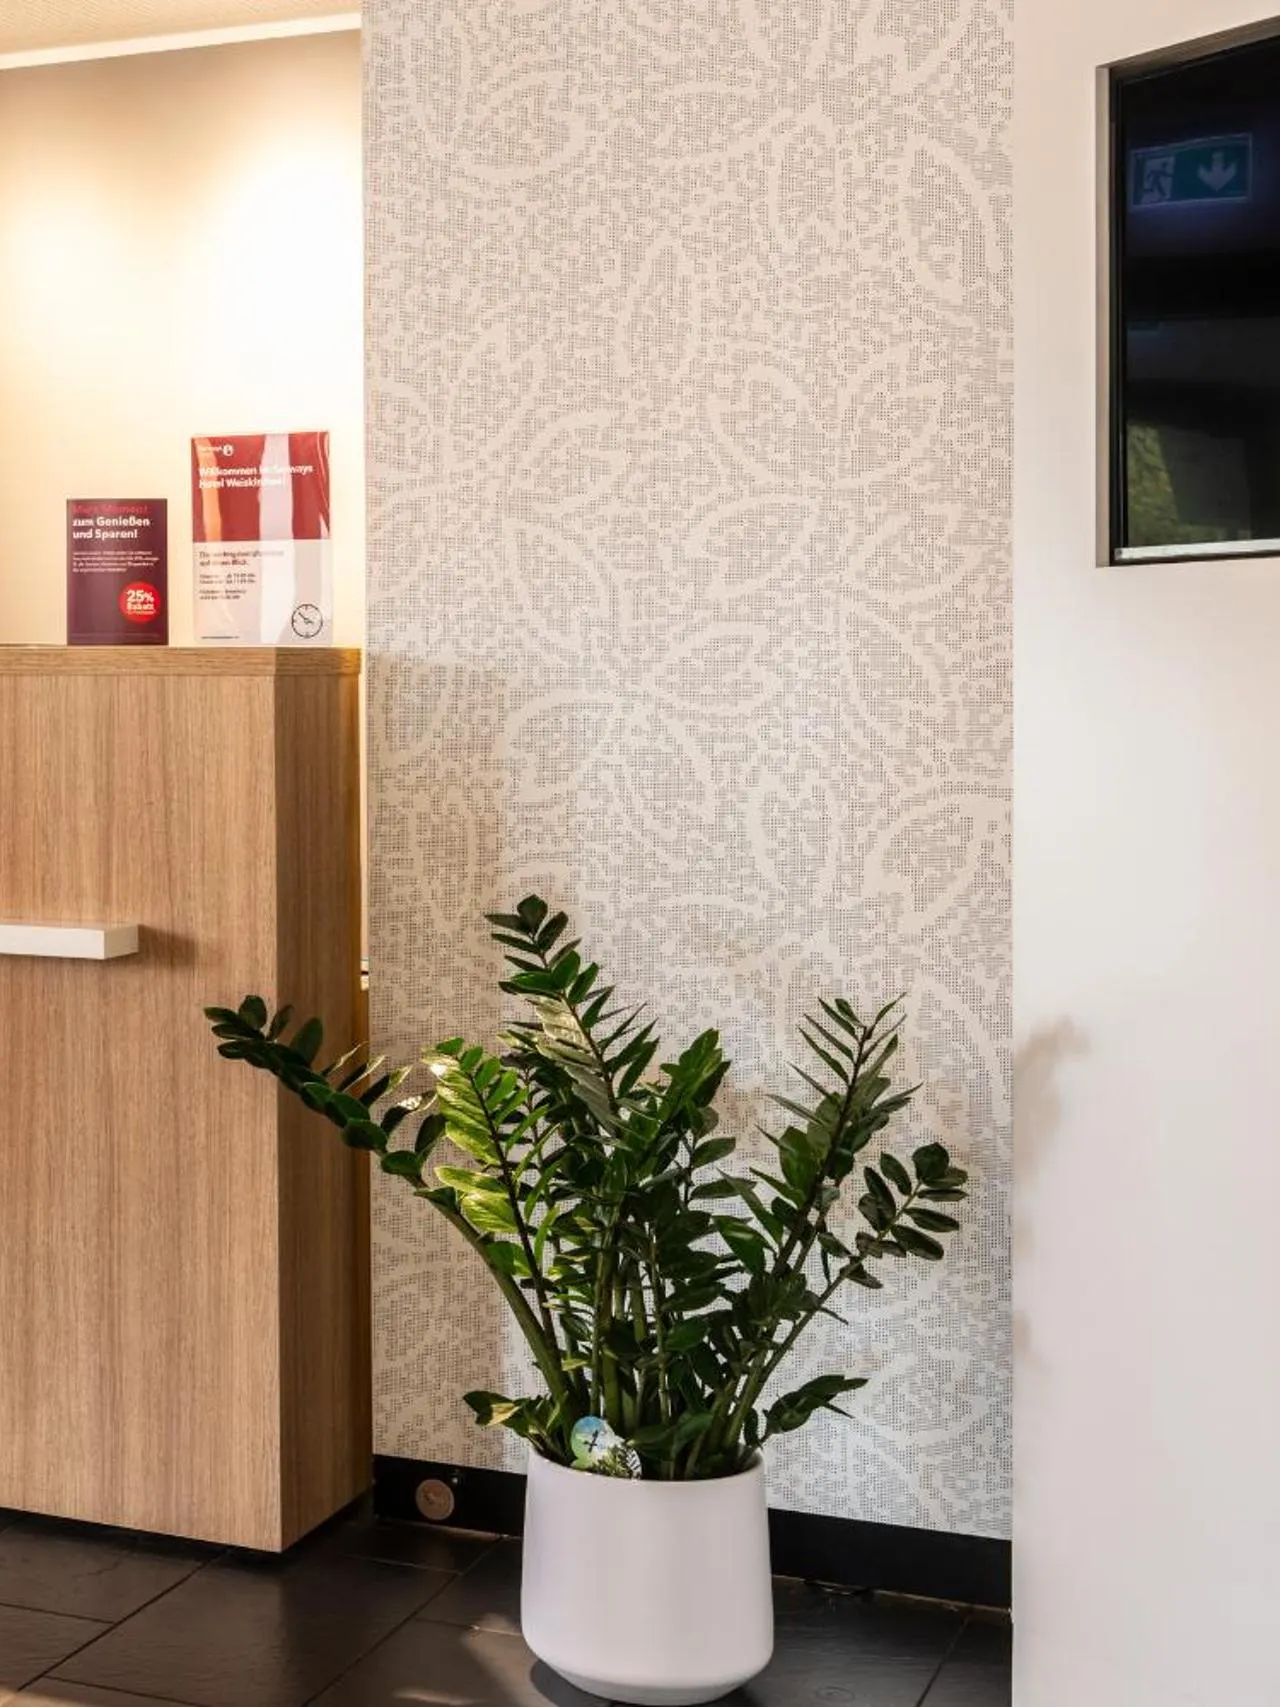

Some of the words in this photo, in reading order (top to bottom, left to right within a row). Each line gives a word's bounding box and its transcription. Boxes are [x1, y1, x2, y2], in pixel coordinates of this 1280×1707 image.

[72, 518, 94, 527] zum
[96, 516, 151, 527] Genießen
[72, 528, 93, 539] und
[94, 529, 138, 541] Sparen!
[126, 589, 155, 603] 25%
